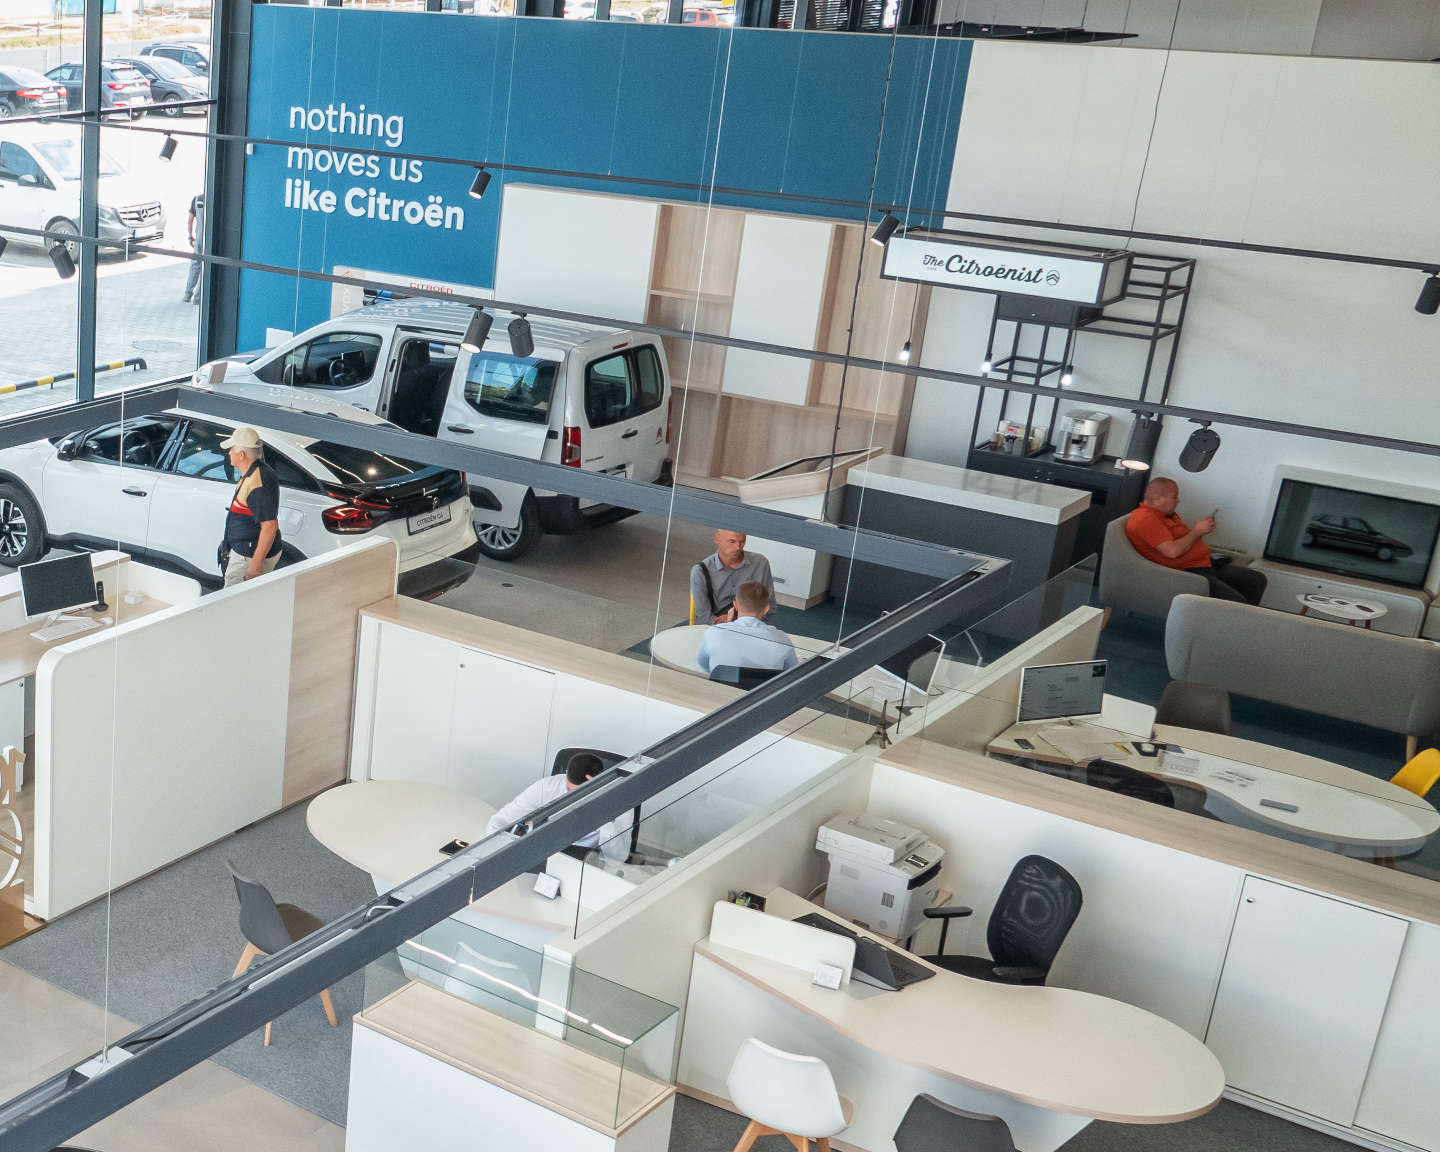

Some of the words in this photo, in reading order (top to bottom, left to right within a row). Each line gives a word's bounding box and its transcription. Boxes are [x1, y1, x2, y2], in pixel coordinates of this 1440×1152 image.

[289, 102, 405, 148] nothing
[287, 146, 380, 178] moves
[389, 157, 423, 183] us
[284, 178, 337, 214] like
[344, 186, 465, 231] Citroën
[922, 254, 945, 267] The
[945, 254, 1044, 284] Citroënist
